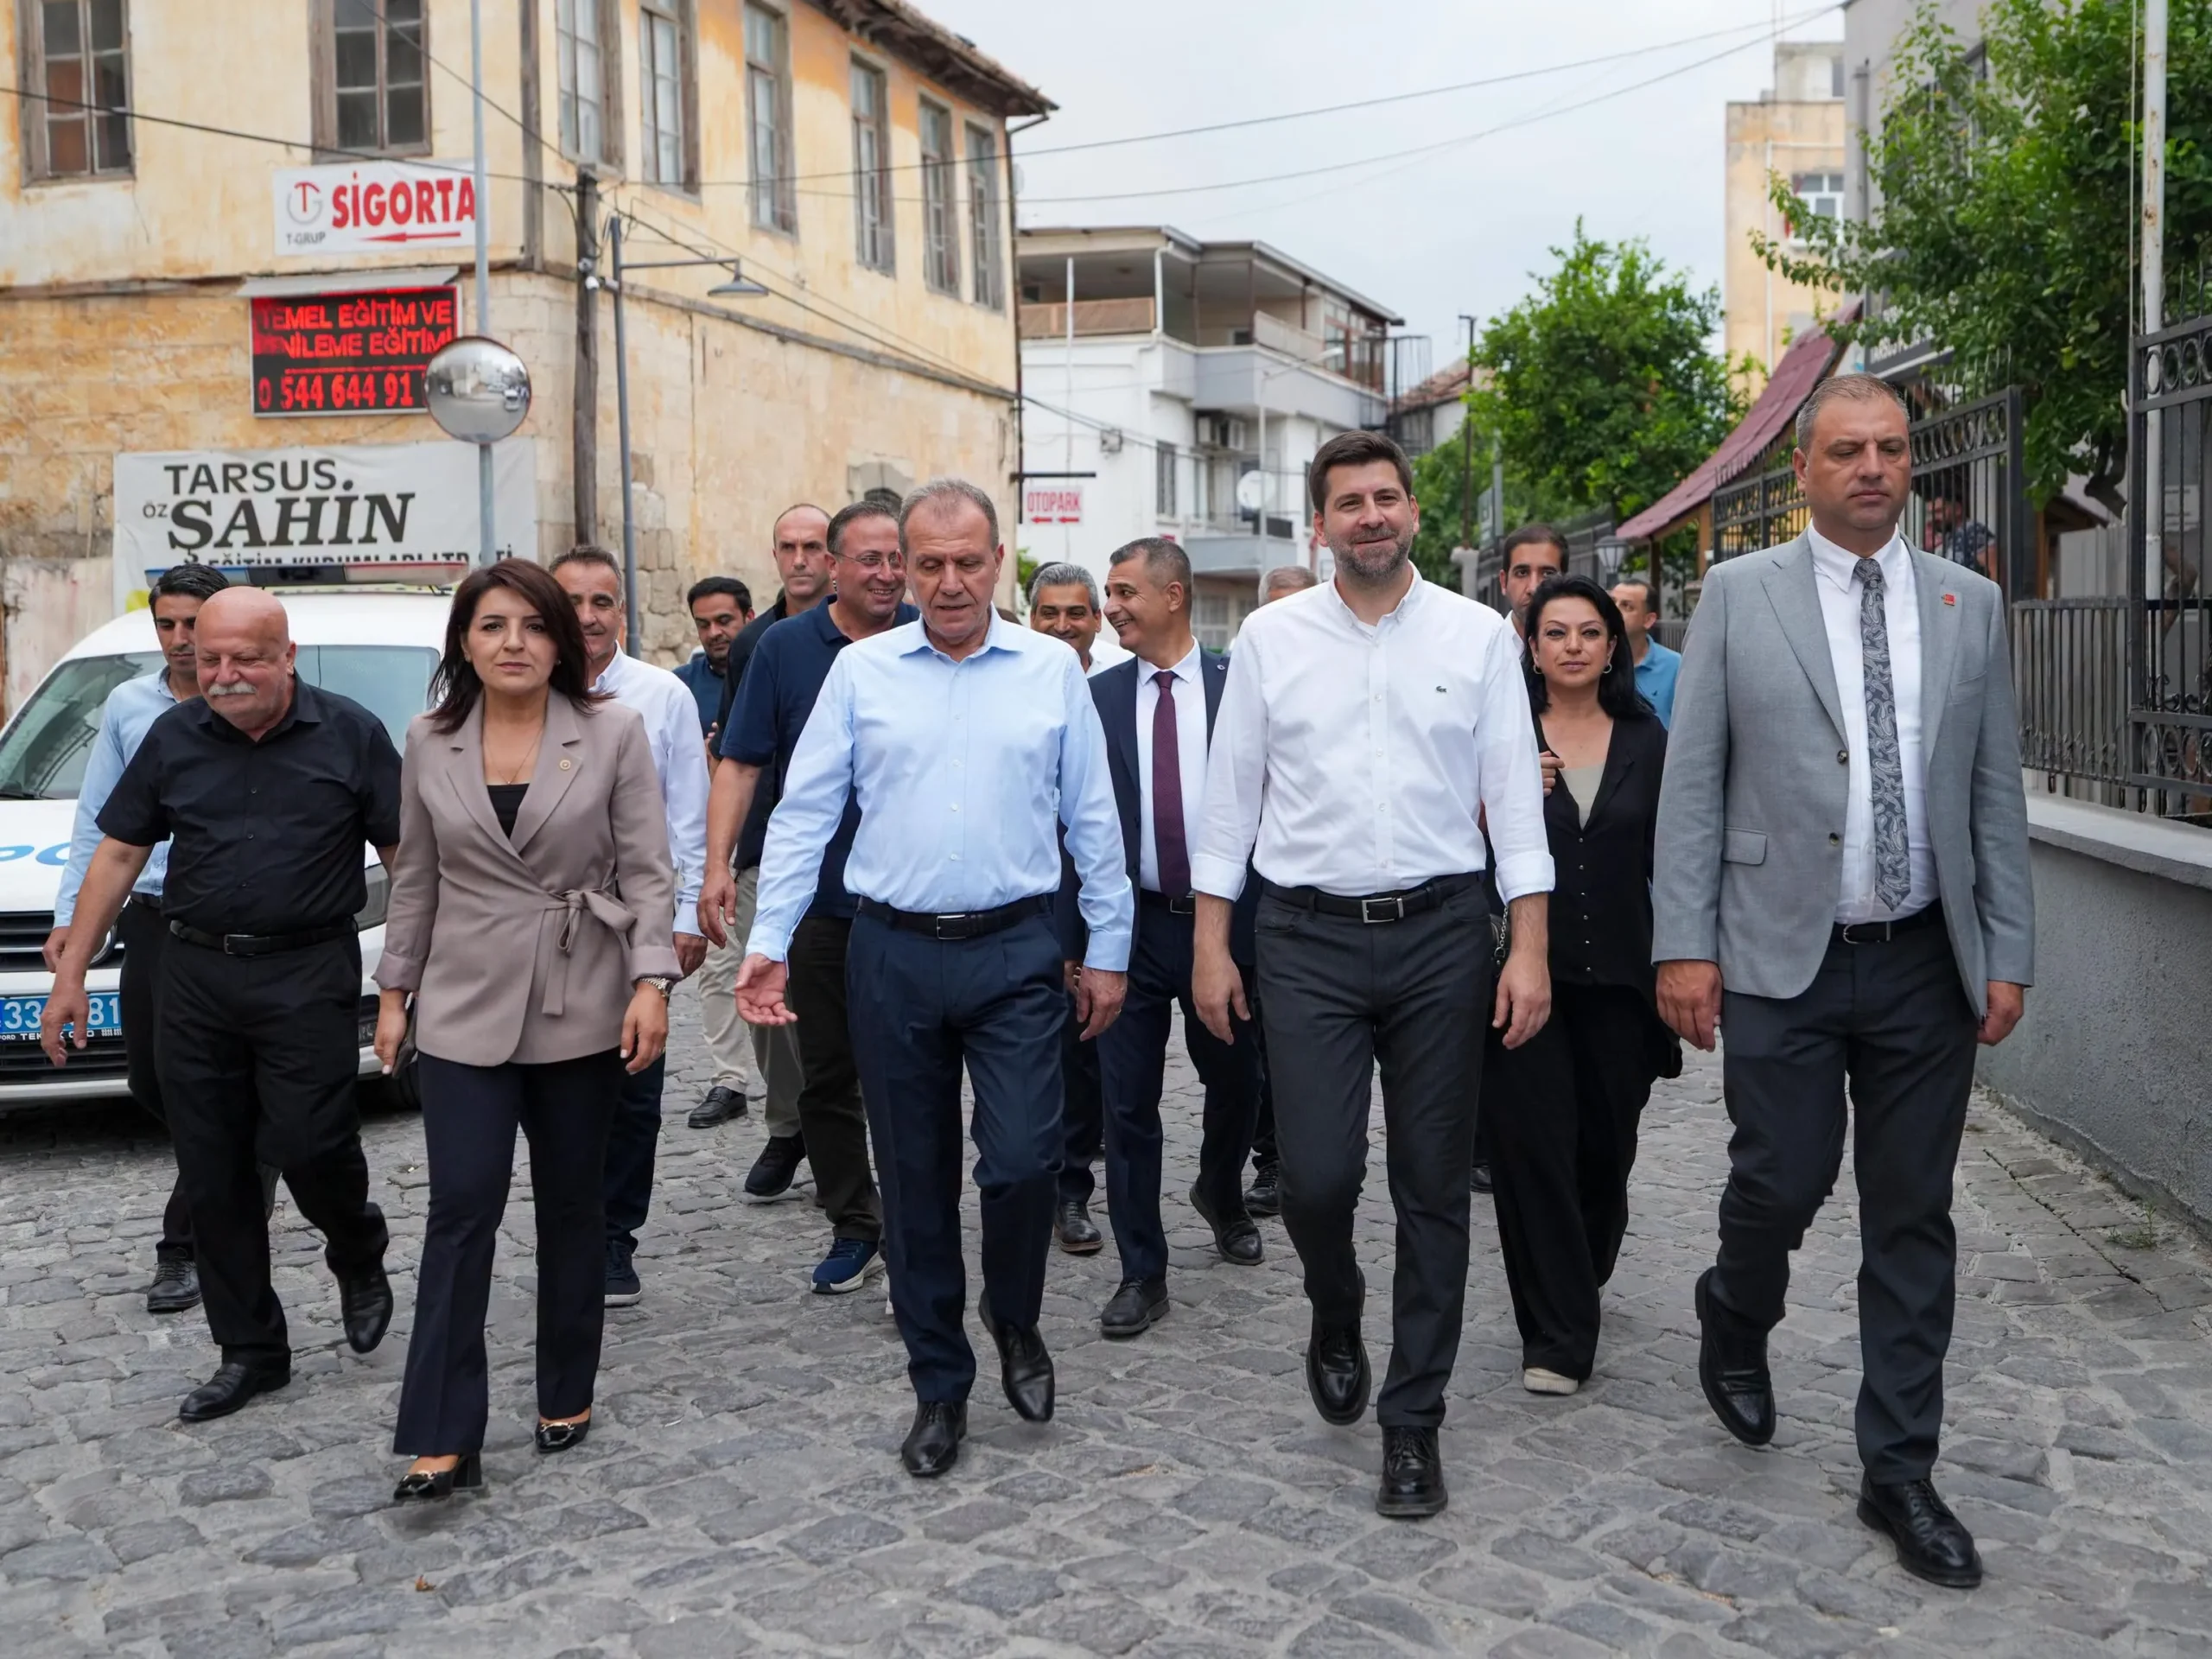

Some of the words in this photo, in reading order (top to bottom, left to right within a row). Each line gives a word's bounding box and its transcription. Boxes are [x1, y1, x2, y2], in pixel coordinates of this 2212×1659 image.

[331, 170, 475, 228] SİGORTA
[286, 232, 326, 245] T-GRUP
[338, 298, 416, 329] EĞİTİM
[420, 300, 452, 325] VE
[257, 377, 272, 410] 0
[279, 375, 325, 410] 544
[331, 373, 378, 408] 644
[384, 372, 414, 407] 91
[164, 459, 337, 496] TARSUS
[1027, 491, 1081, 512] OTOPARK
[143, 501, 168, 518] ÖZ
[168, 479, 416, 564] ŞAHİN
[4, 1001, 42, 1029] 33
